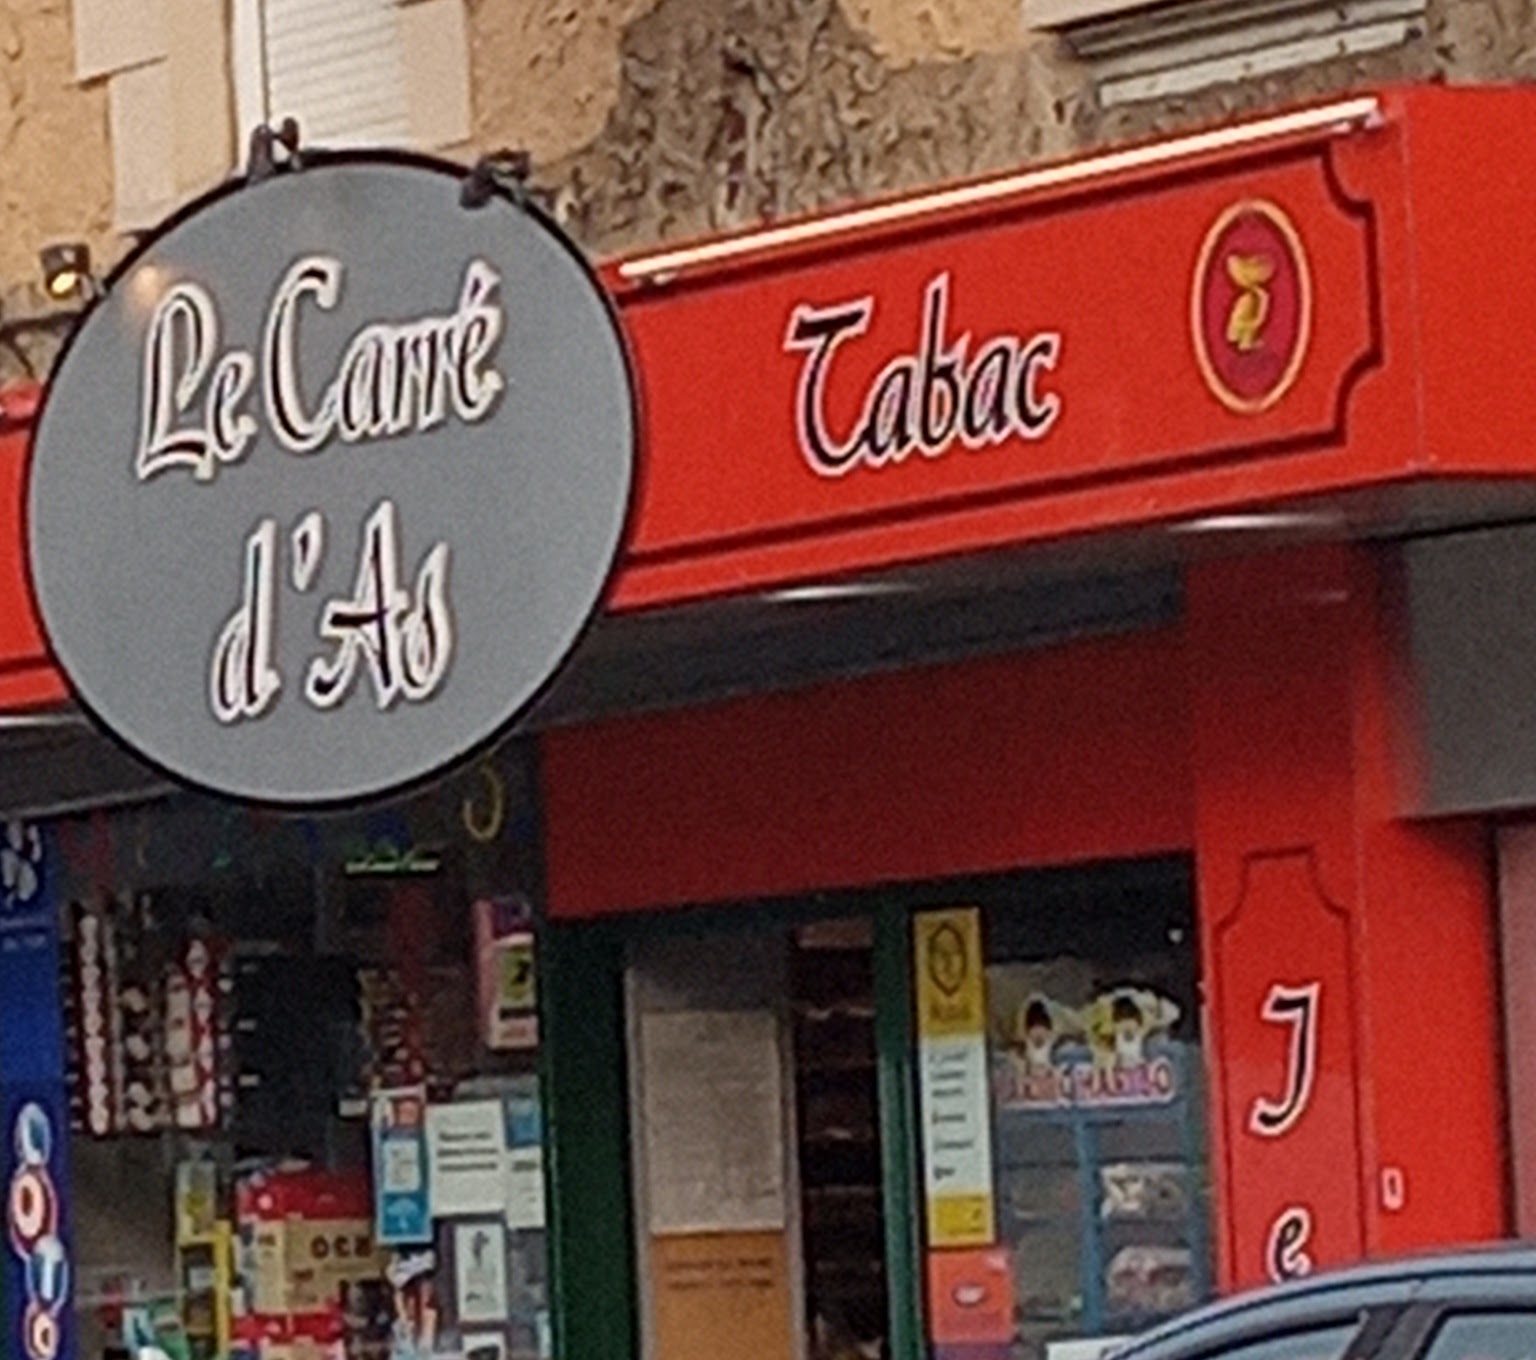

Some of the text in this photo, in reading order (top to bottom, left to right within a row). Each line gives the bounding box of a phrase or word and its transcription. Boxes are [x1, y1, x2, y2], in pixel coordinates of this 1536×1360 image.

[136, 254, 508, 482] Le Carré
[782, 270, 1062, 478] Tabac
[210, 498, 459, 724] d'As
